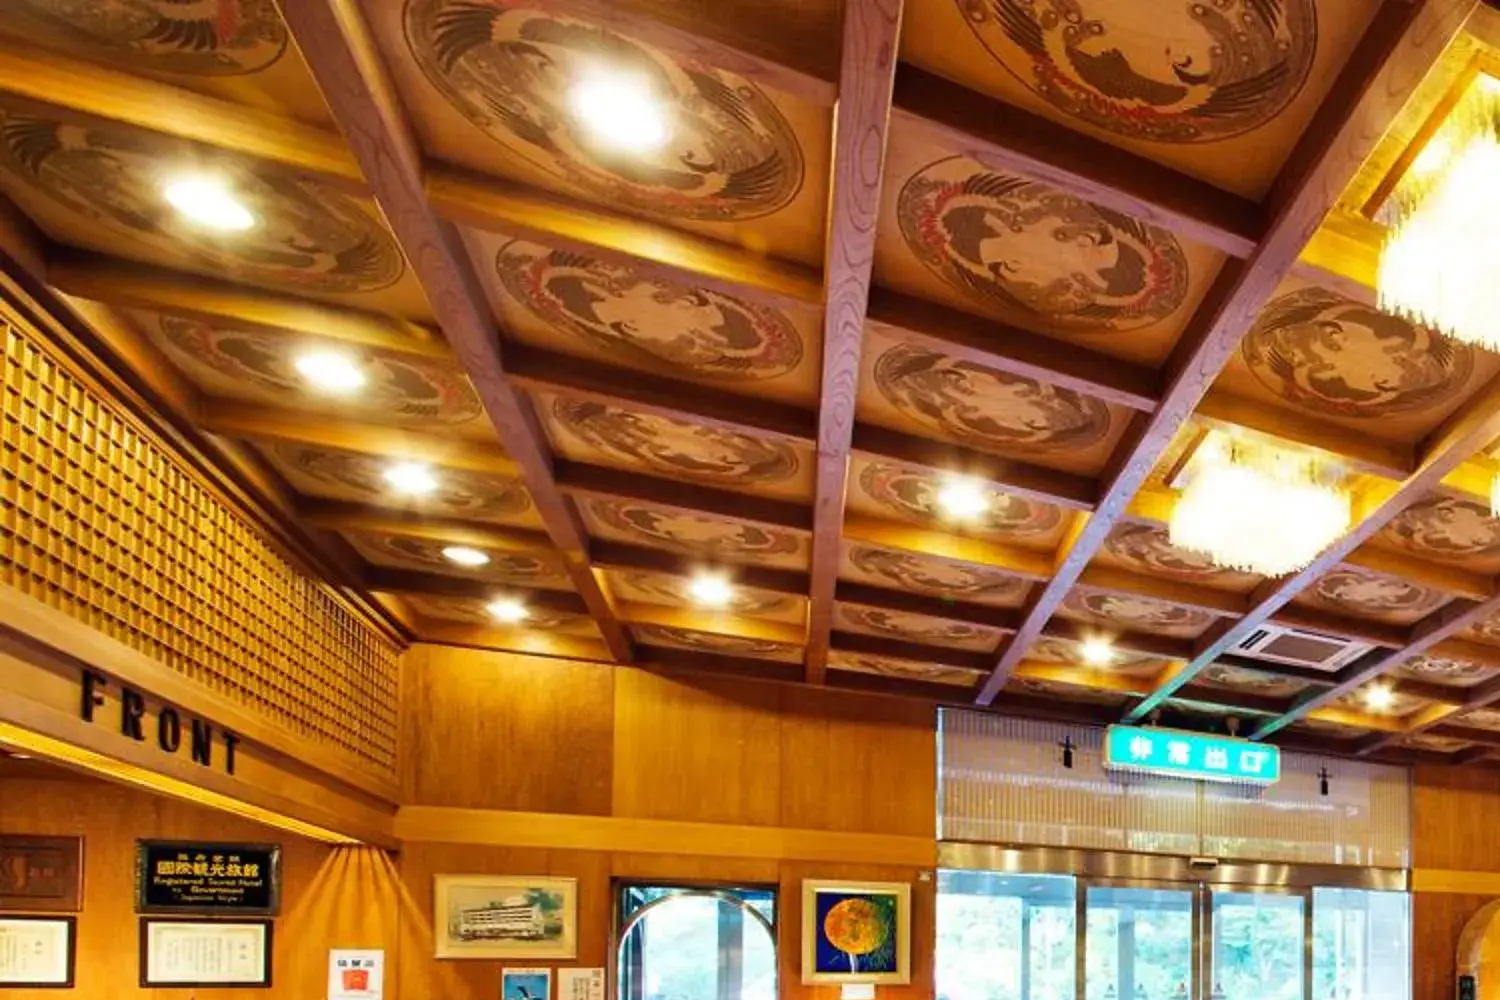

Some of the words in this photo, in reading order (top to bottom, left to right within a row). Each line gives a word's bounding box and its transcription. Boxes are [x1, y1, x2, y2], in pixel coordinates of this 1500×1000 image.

[81, 669, 241, 776] FRONT
[1129, 736, 1263, 774] 非常出口
